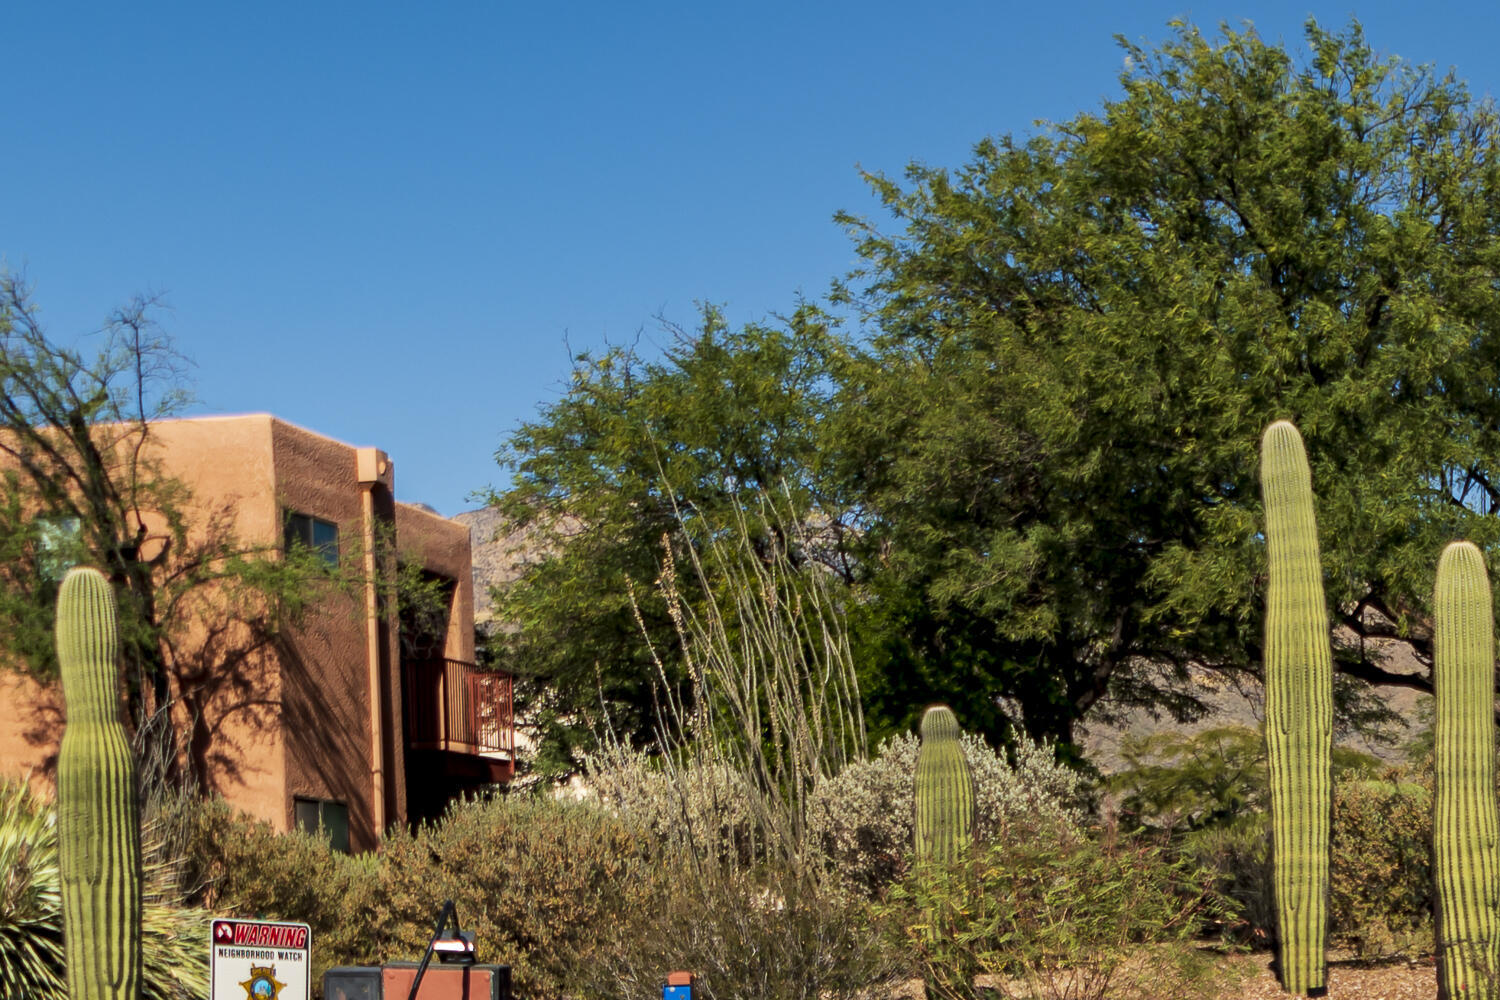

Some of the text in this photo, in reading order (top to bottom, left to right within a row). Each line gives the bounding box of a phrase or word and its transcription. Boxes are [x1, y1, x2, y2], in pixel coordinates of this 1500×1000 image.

[234, 924, 308, 948] WARNING
[218, 948, 303, 962] NEIGHBORHOOD WATCH
